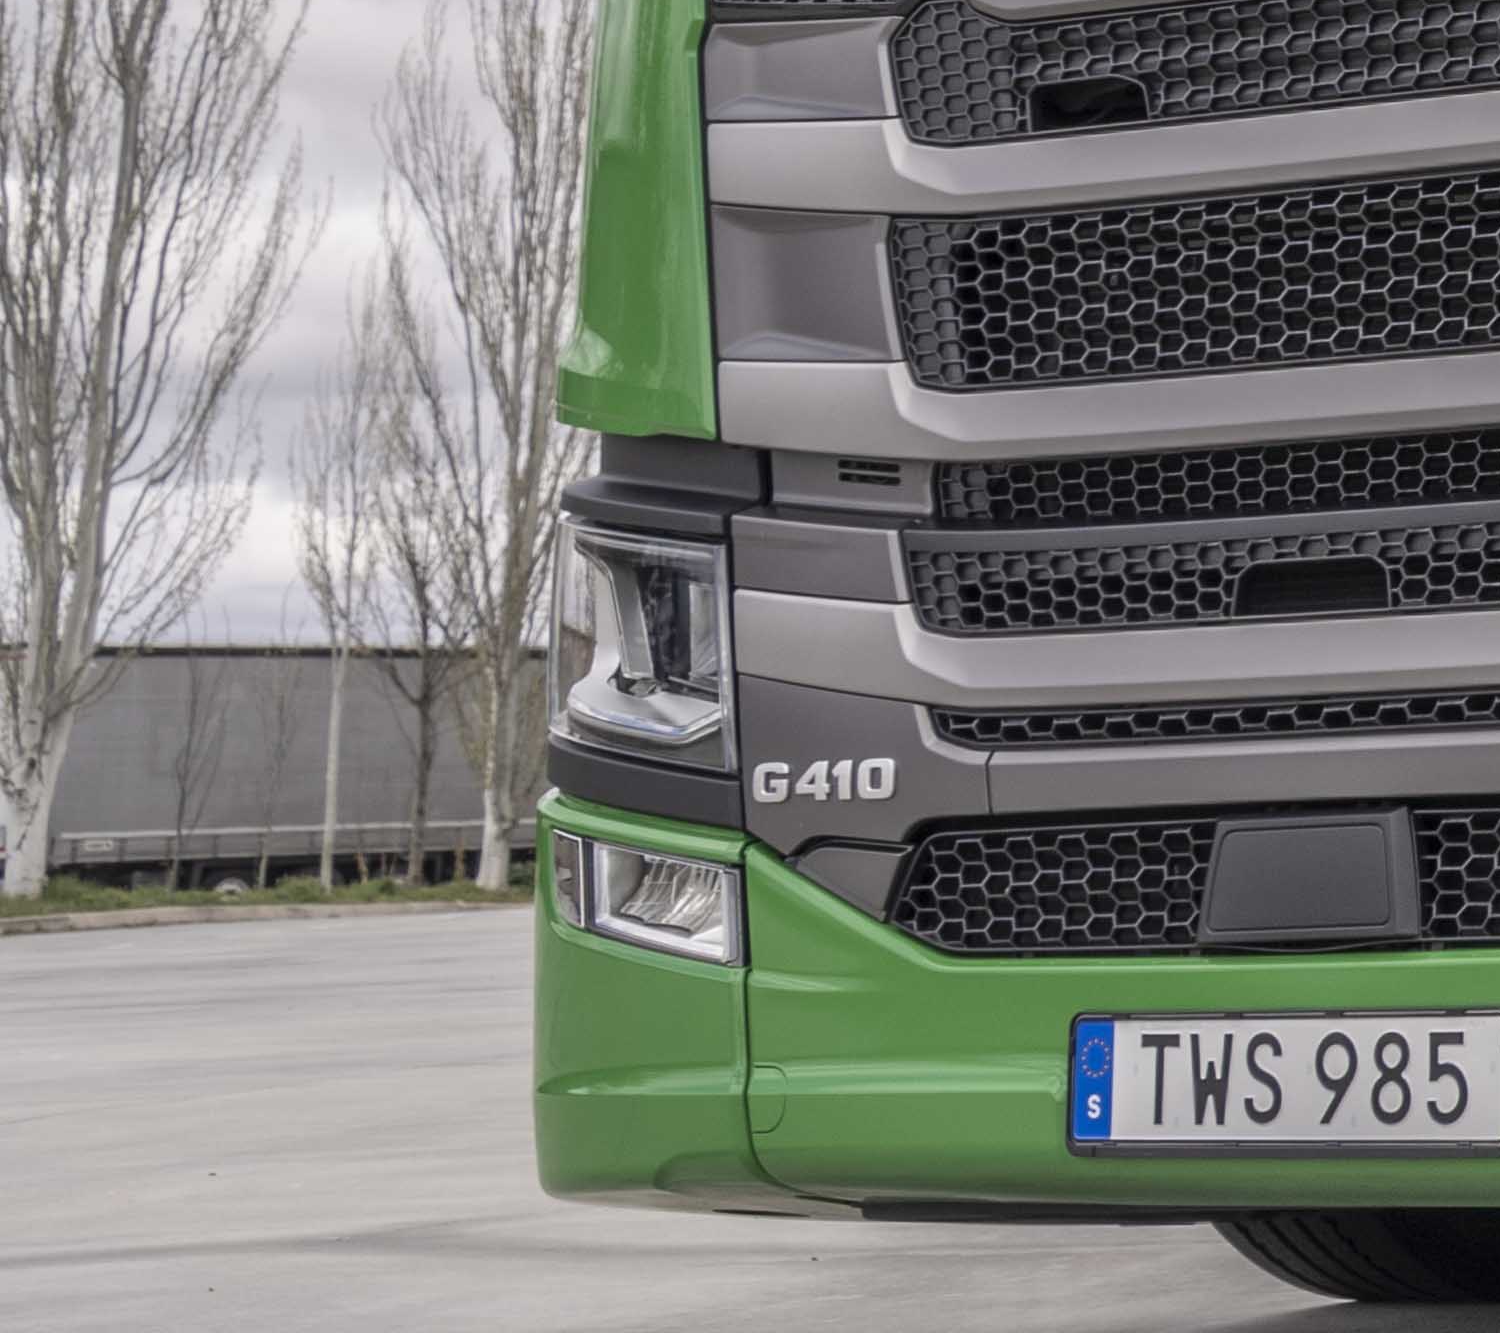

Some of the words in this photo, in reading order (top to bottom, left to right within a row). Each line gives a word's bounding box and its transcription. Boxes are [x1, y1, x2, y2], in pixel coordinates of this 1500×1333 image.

[752, 757, 897, 804] G410
[1140, 1031, 1283, 1126] TWS
[1314, 1030, 1469, 1126] 985
[1086, 1094, 1102, 1120] S
